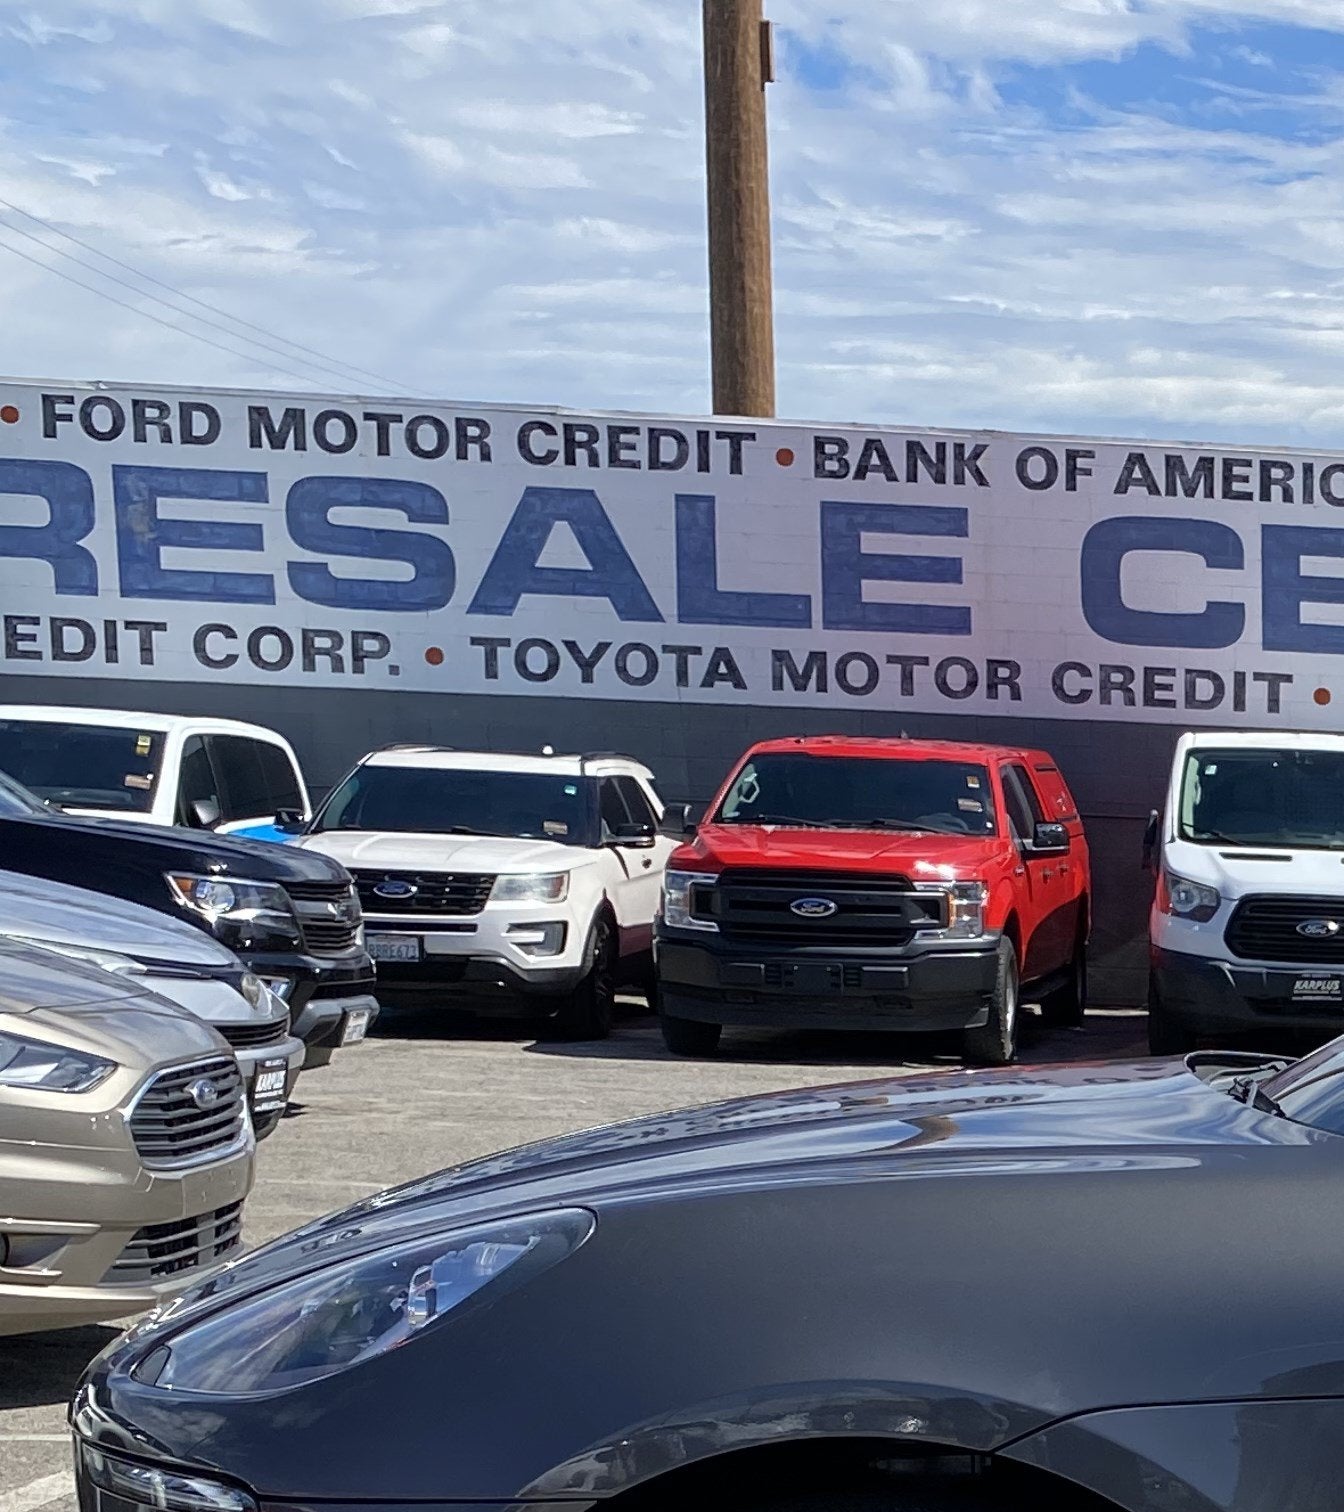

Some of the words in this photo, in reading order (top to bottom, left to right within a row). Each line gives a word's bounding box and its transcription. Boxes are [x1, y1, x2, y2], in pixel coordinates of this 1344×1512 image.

[41, 393, 221, 446] FORD
[248, 405, 493, 463] MOTOR
[517, 421, 757, 476] CREDIT
[813, 436, 991, 488] BANK
[1015, 446, 1097, 492] OF
[0, 457, 972, 637] RESALE
[3, 614, 168, 666] EDIT
[193, 621, 401, 676] CORP.
[470, 636, 748, 691] TOYOTA
[771, 648, 1023, 702] MOTOR
[1051, 661, 1294, 714] CREDIT
